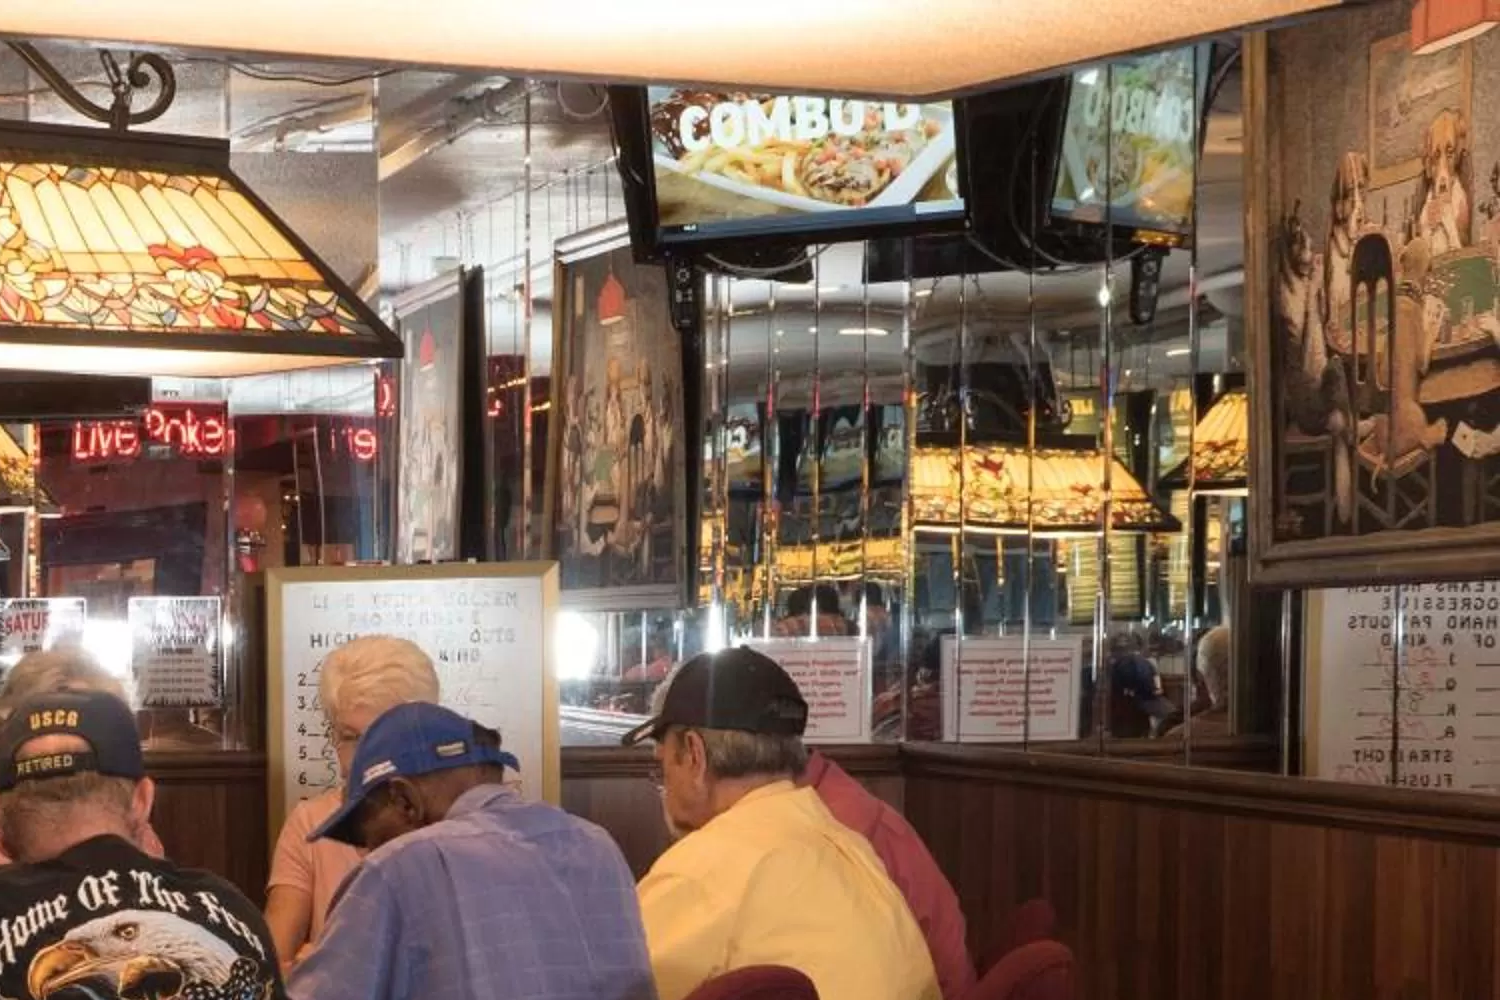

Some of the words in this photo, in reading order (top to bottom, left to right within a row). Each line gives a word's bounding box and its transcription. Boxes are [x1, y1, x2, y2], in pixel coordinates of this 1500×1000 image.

[297, 724, 308, 738] 4
[16, 753, 74, 776] RETIRED
[298, 772, 308, 786] 6
[128, 869, 190, 914] The
